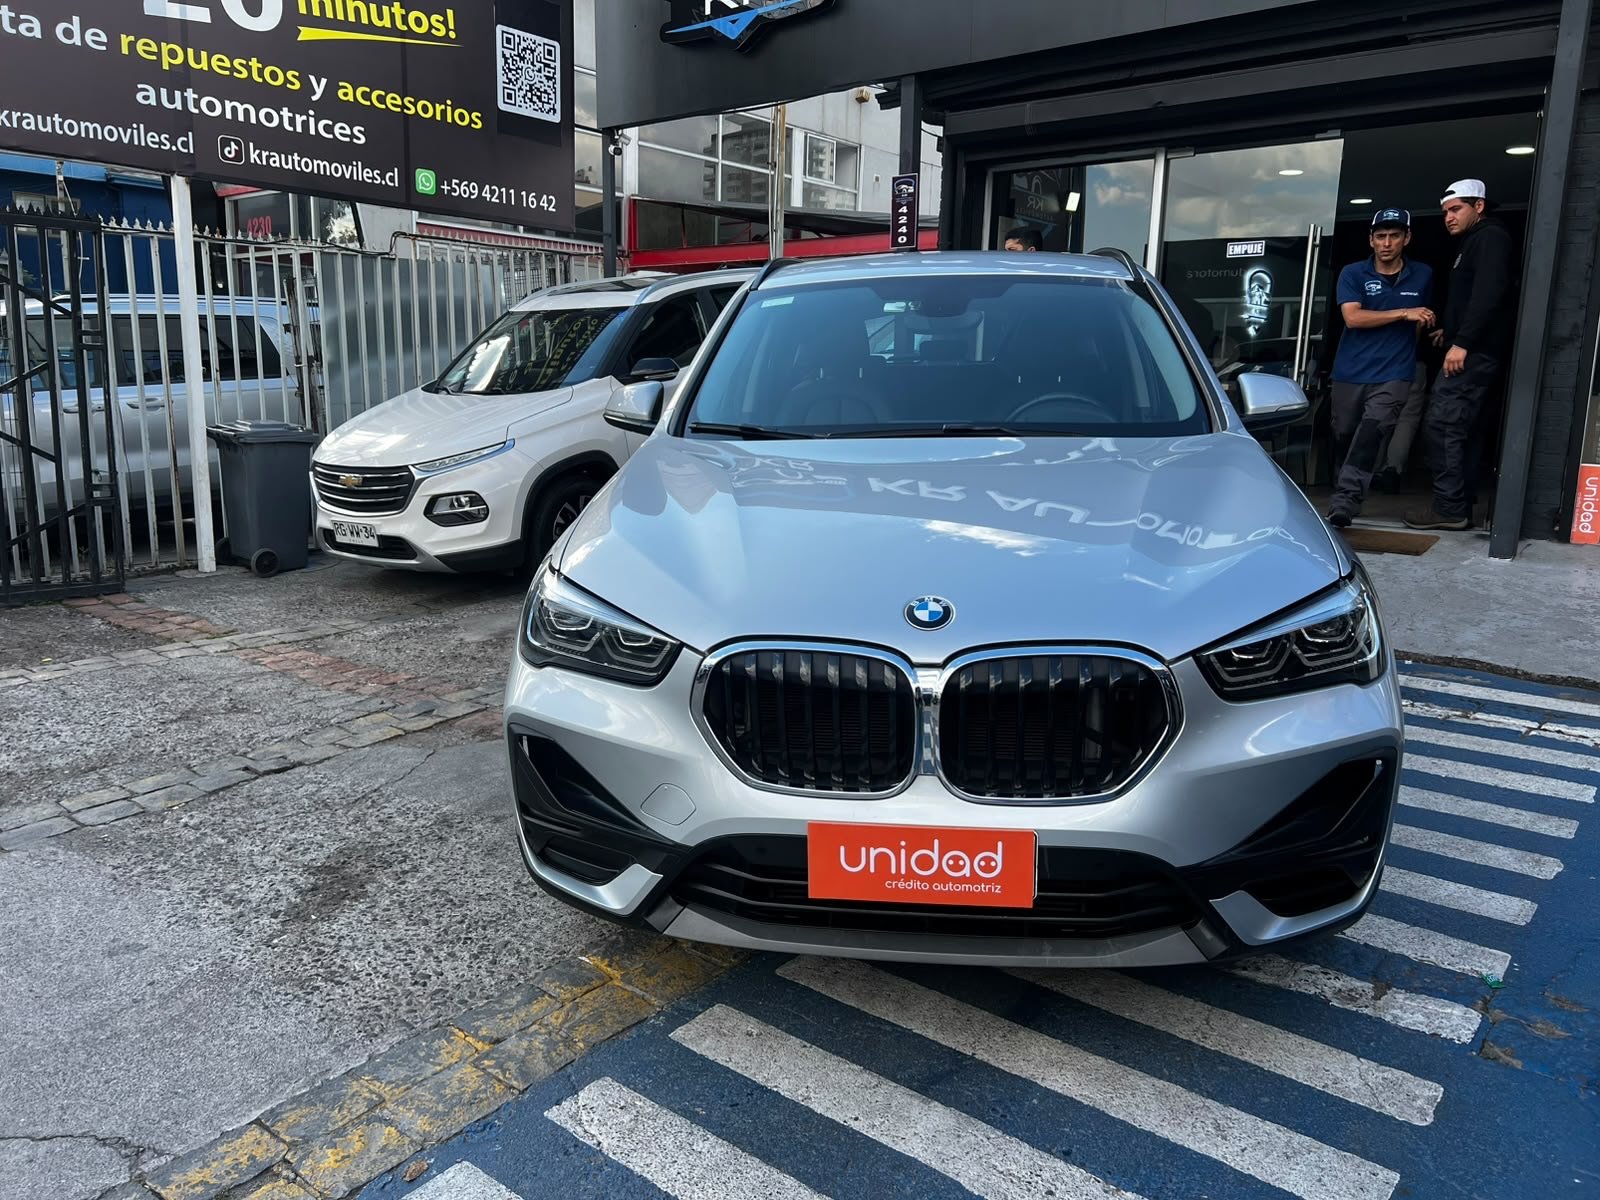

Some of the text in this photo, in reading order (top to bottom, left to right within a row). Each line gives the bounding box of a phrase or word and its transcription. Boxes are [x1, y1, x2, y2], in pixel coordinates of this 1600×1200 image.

[55, 16, 108, 51] de
[120, 33, 301, 90] repuestos
[308, 74, 328, 101] y
[337, 81, 483, 130] accesorios
[136, 83, 366, 145] automotrices
[250, 142, 399, 188] krautomoviles.cl
[440, 179, 557, 212] +569 4211 16 42
[897, 205, 908, 243] 4240
[1229, 243, 1263, 255] EMPUJE
[1579, 476, 1600, 534] unidad
[839, 838, 1003, 878] unidad
[885, 879, 1002, 893] crédito automotriz
